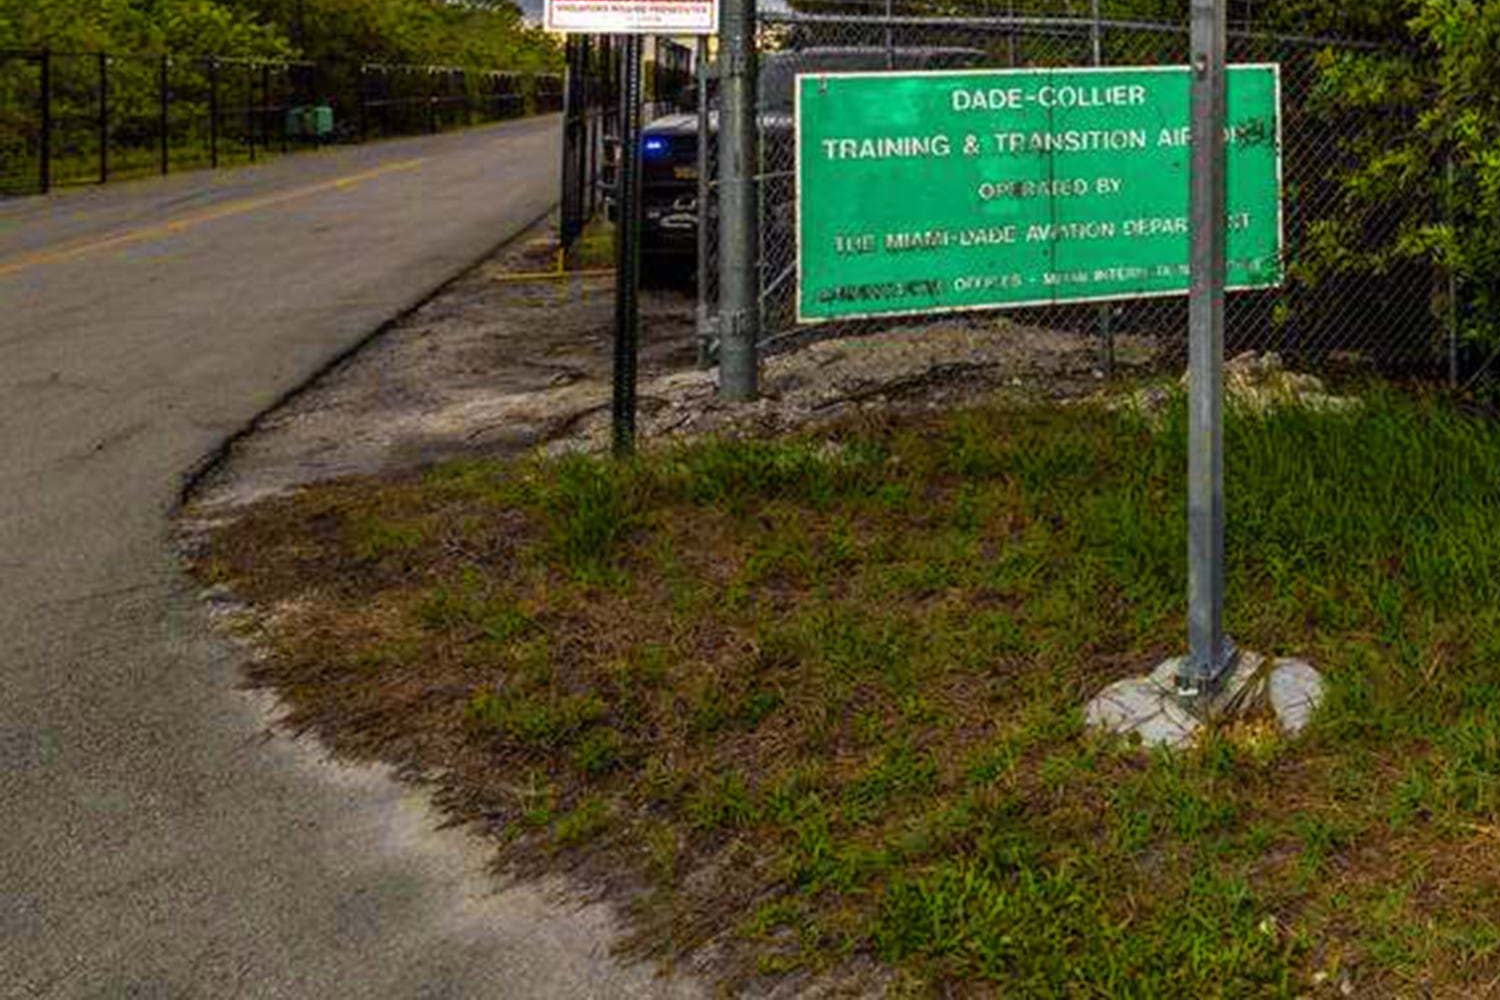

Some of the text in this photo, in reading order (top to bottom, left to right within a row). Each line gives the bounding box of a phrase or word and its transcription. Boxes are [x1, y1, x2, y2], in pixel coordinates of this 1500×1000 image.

[952, 85, 1146, 111] DADE-COLLIER
[822, 135, 950, 159] TRAINING
[963, 134, 981, 156] &
[995, 128, 1146, 152] TRANSITION
[1096, 178, 1121, 194] BY
[885, 225, 1016, 248] MIAMI-DADE
[1026, 221, 1115, 243] AVIATION
